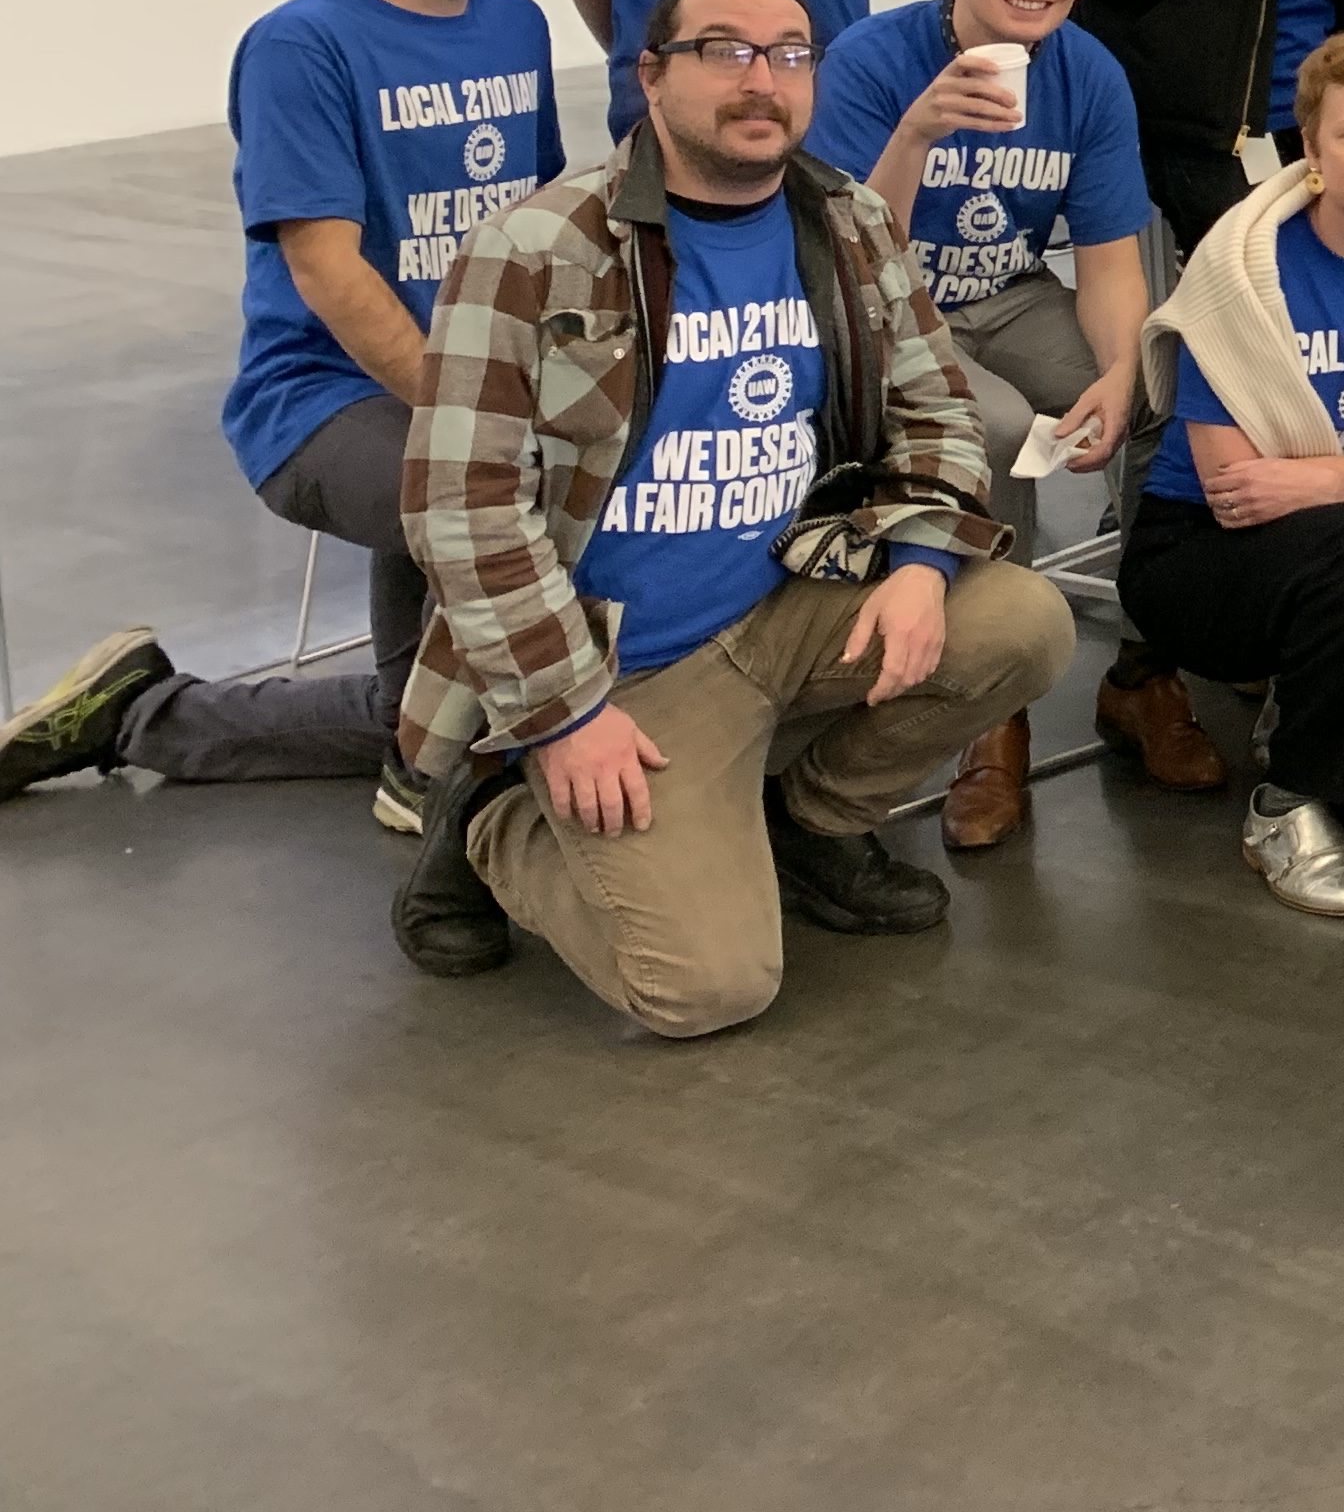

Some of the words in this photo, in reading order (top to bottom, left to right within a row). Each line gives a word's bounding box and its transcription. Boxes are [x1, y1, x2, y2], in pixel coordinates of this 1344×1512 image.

[379, 83, 464, 131] LOCAL
[462, 75, 508, 122] 2110
[921, 145, 969, 189] CAL
[408, 190, 451, 236] WE
[972, 212, 999, 227] UAW
[747, 379, 777, 397] UAW
[653, 430, 710, 482] WE
[601, 485, 628, 534] A
[634, 482, 716, 535] FAIR
